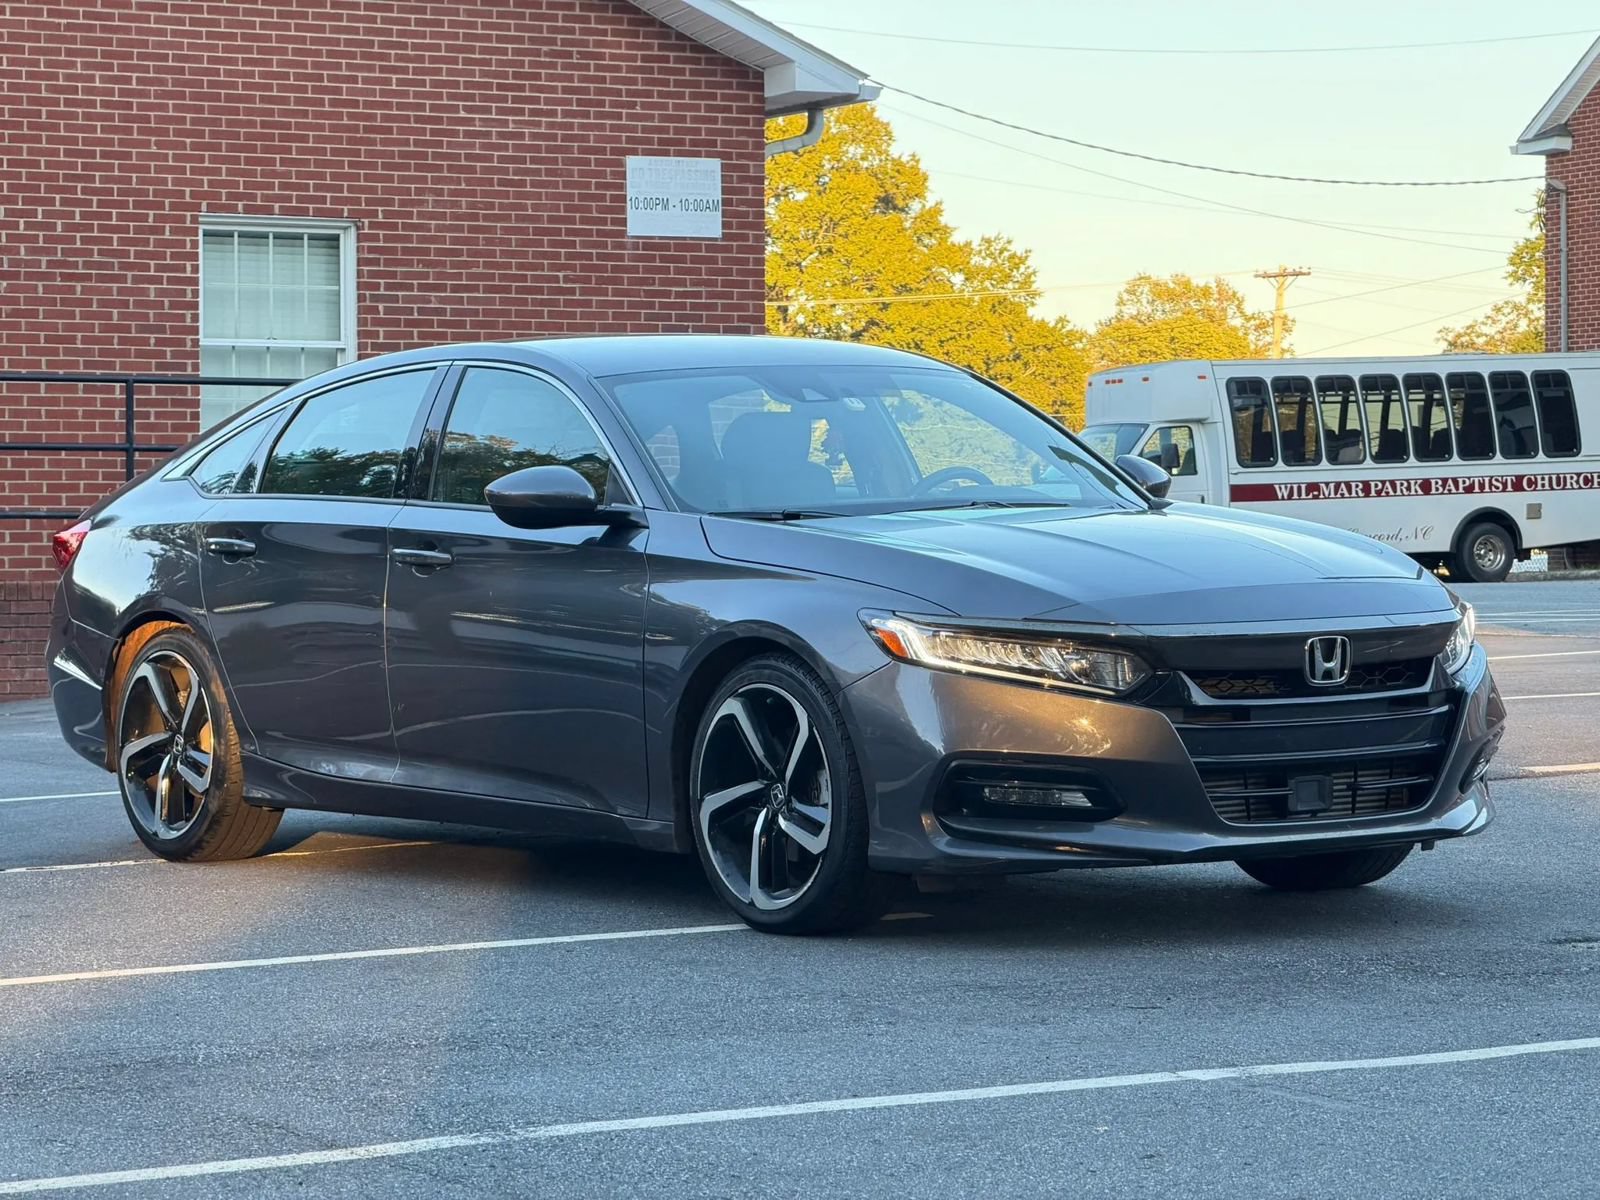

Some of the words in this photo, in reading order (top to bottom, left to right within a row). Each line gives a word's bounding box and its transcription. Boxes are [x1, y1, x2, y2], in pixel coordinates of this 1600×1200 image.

[629, 196, 670, 211] 10:00PM
[679, 198, 720, 213] 10:00AM
[1273, 483, 1365, 500] WIL-MAR
[1369, 479, 1424, 497] PARK
[1430, 475, 1516, 494] BAPTIST
[1405, 525, 1434, 540] NC
